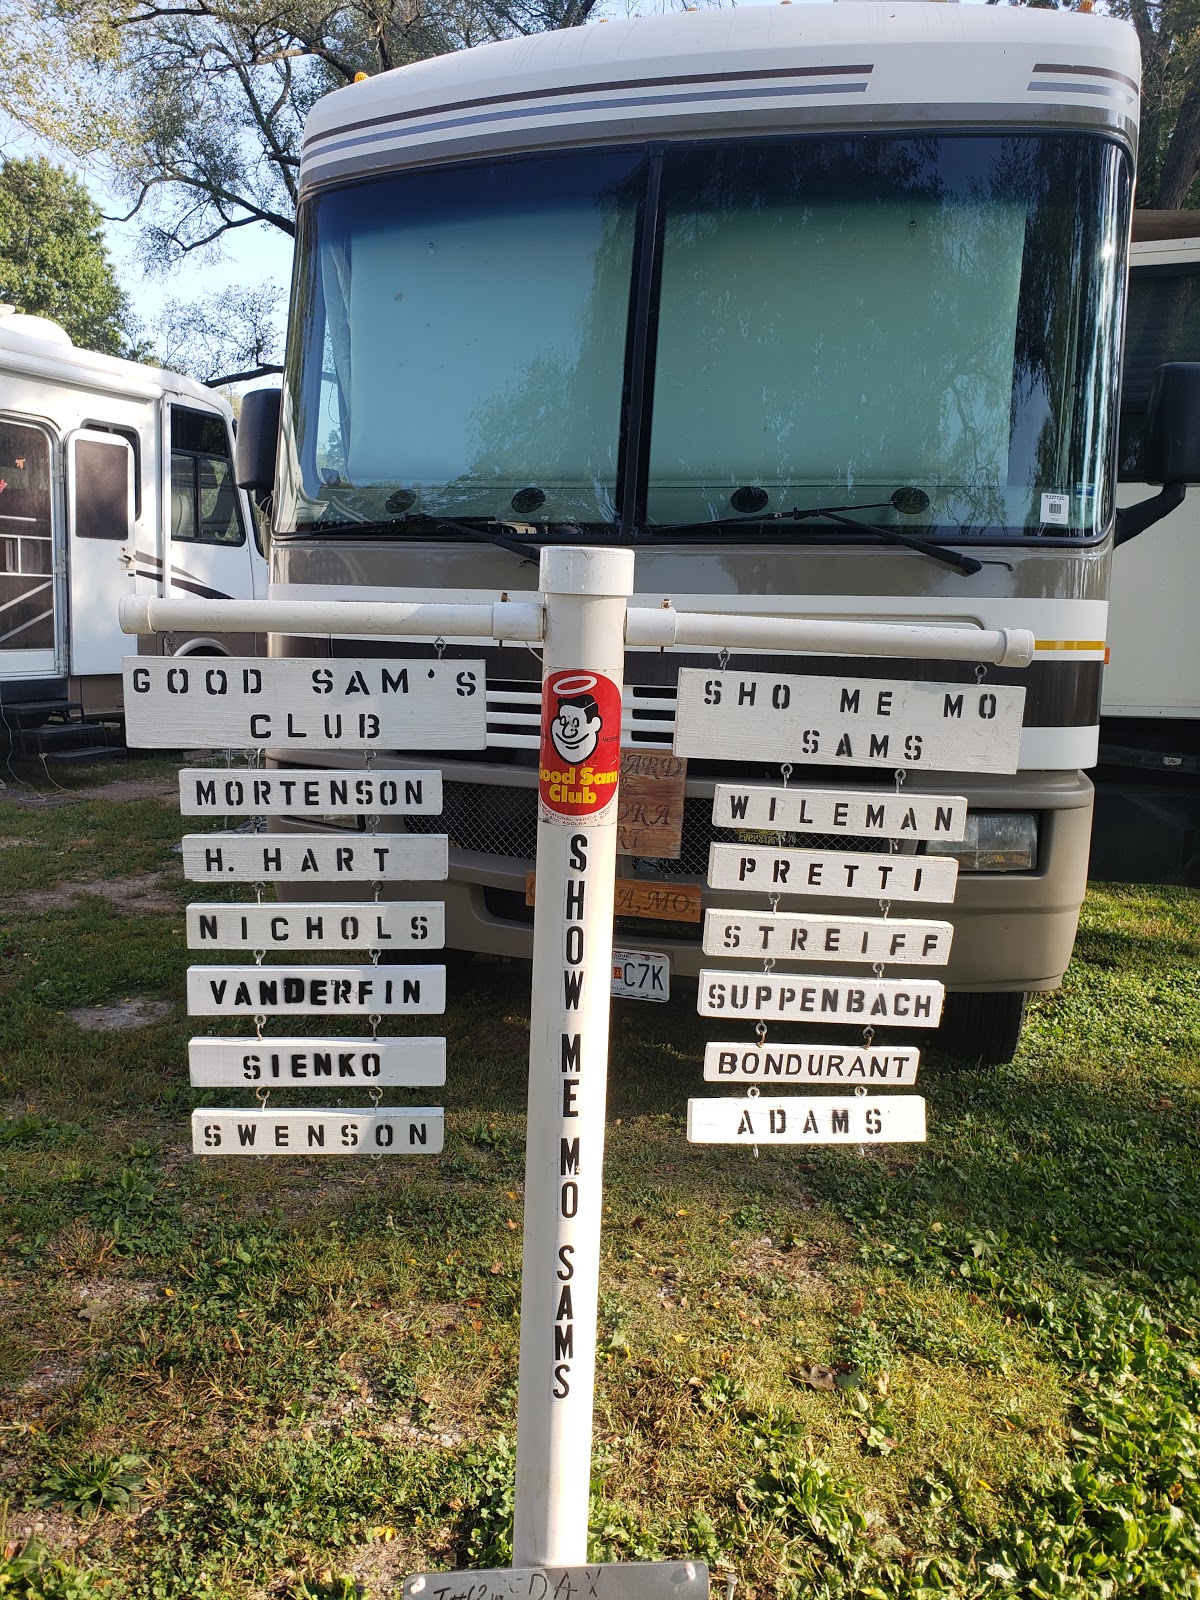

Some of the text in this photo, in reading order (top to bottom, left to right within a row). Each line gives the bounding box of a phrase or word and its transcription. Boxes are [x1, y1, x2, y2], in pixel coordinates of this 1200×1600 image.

[133, 668, 477, 697] GOOD SAM'S
[703, 680, 997, 719] SHO ME MO
[250, 713, 381, 739] CLUB
[801, 729, 923, 761] SAMS
[580, 767, 618, 786] Sam
[196, 779, 424, 806] MORTENSON
[549, 783, 597, 804] Club
[730, 795, 953, 832] WILEMAN
[205, 848, 390, 872] H. HART
[739, 857, 922, 892] PRETTI
[199, 915, 429, 941] NICHOLS
[723, 925, 939, 957] STREIFF
[209, 977, 421, 1006] VANDERFIN
[708, 983, 932, 1018] SUPPENBACH
[243, 1053, 381, 1079] SIENKO
[718, 1051, 911, 1078] BONDURANT
[553, 834, 588, 1399] SHOW ME MO SAMS
[737, 1108, 882, 1135] ADAMS
[204, 1123, 427, 1147] SWENSON
